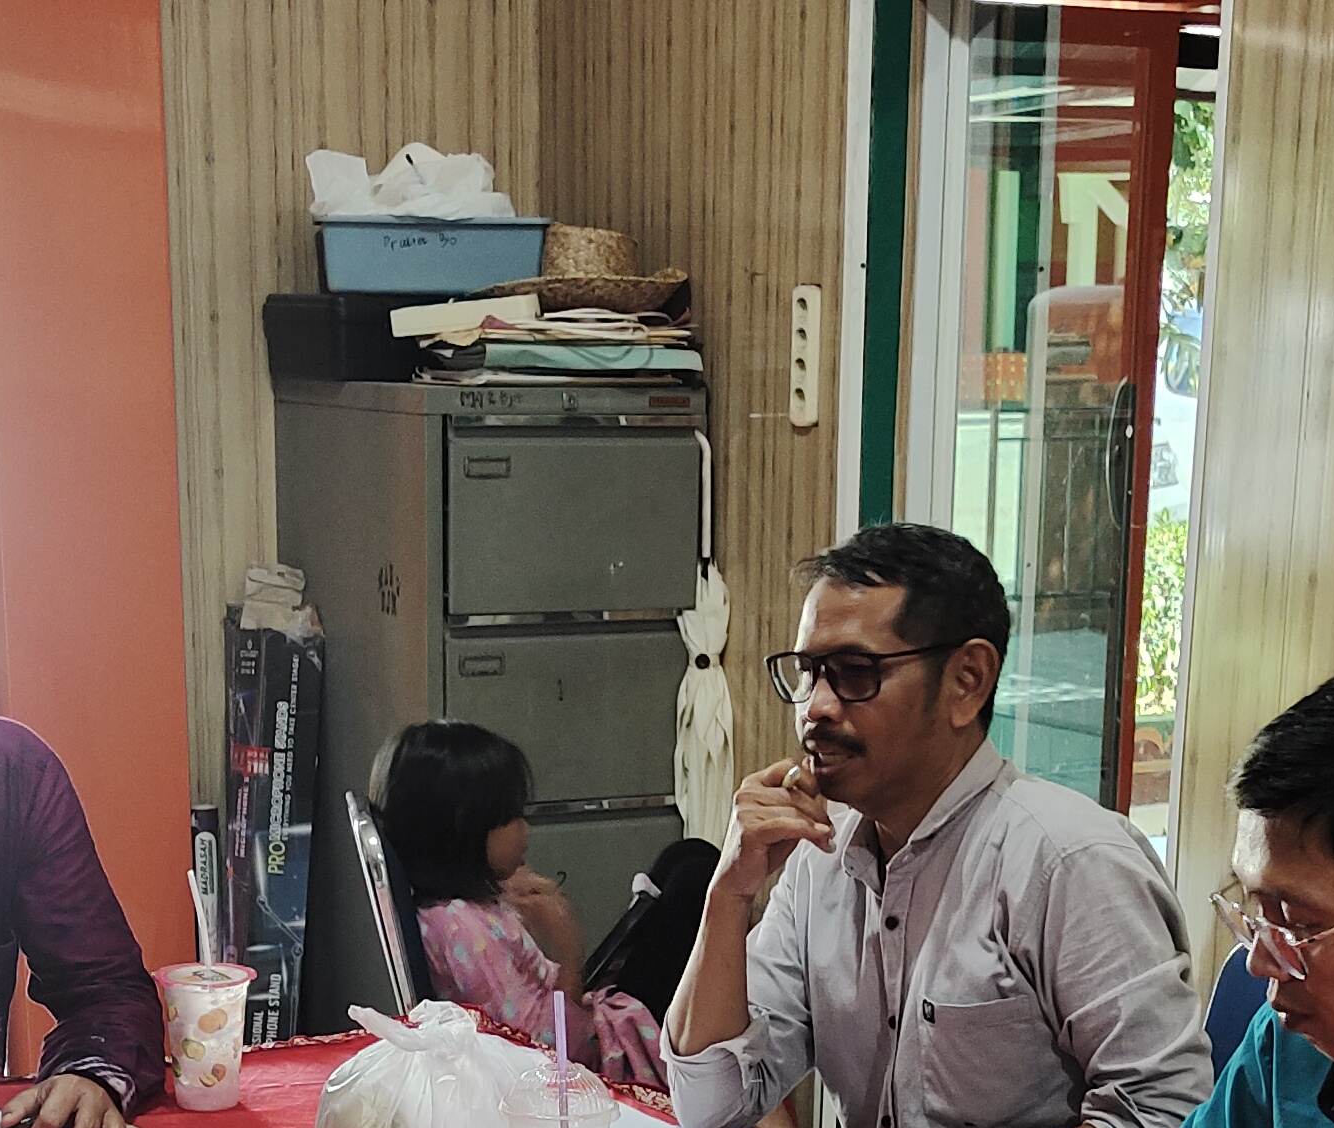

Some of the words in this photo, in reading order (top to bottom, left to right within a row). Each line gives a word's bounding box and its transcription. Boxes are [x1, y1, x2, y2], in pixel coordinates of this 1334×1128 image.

[274, 701, 289, 750] STANDS
[199, 837, 209, 896] MADRASAH
[268, 973, 282, 1007] STAND
[252, 1010, 264, 1044] SIONAL
